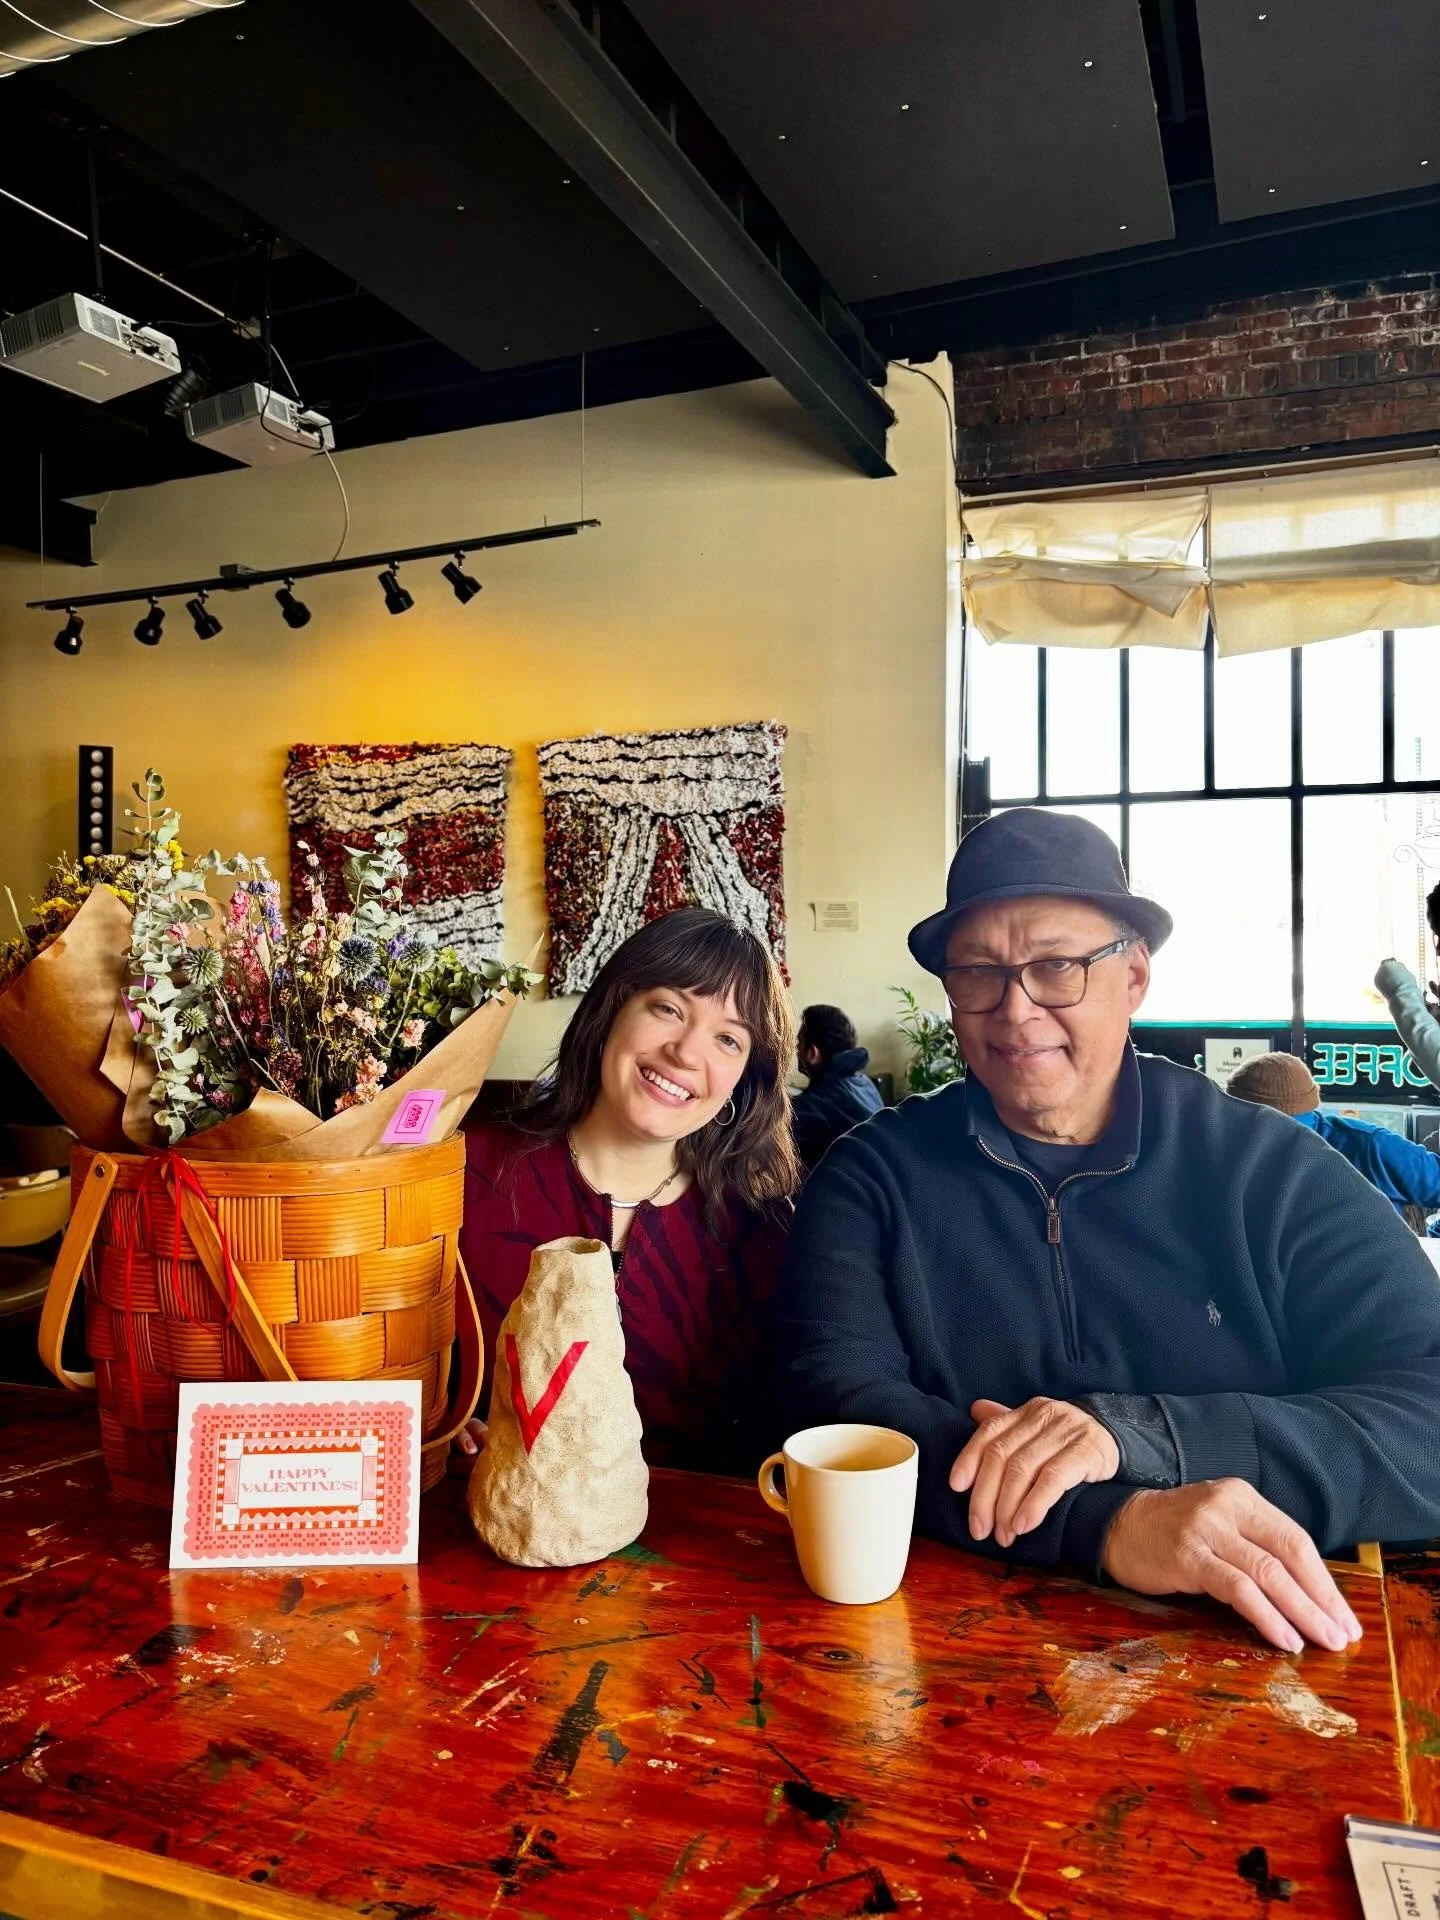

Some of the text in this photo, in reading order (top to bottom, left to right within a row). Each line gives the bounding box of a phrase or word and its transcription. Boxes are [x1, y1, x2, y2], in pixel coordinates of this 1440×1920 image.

[268, 1467, 331, 1479] HAPPY
[241, 1480, 359, 1493] VALENTINES!
[1397, 1877, 1420, 1917] DRAFT
